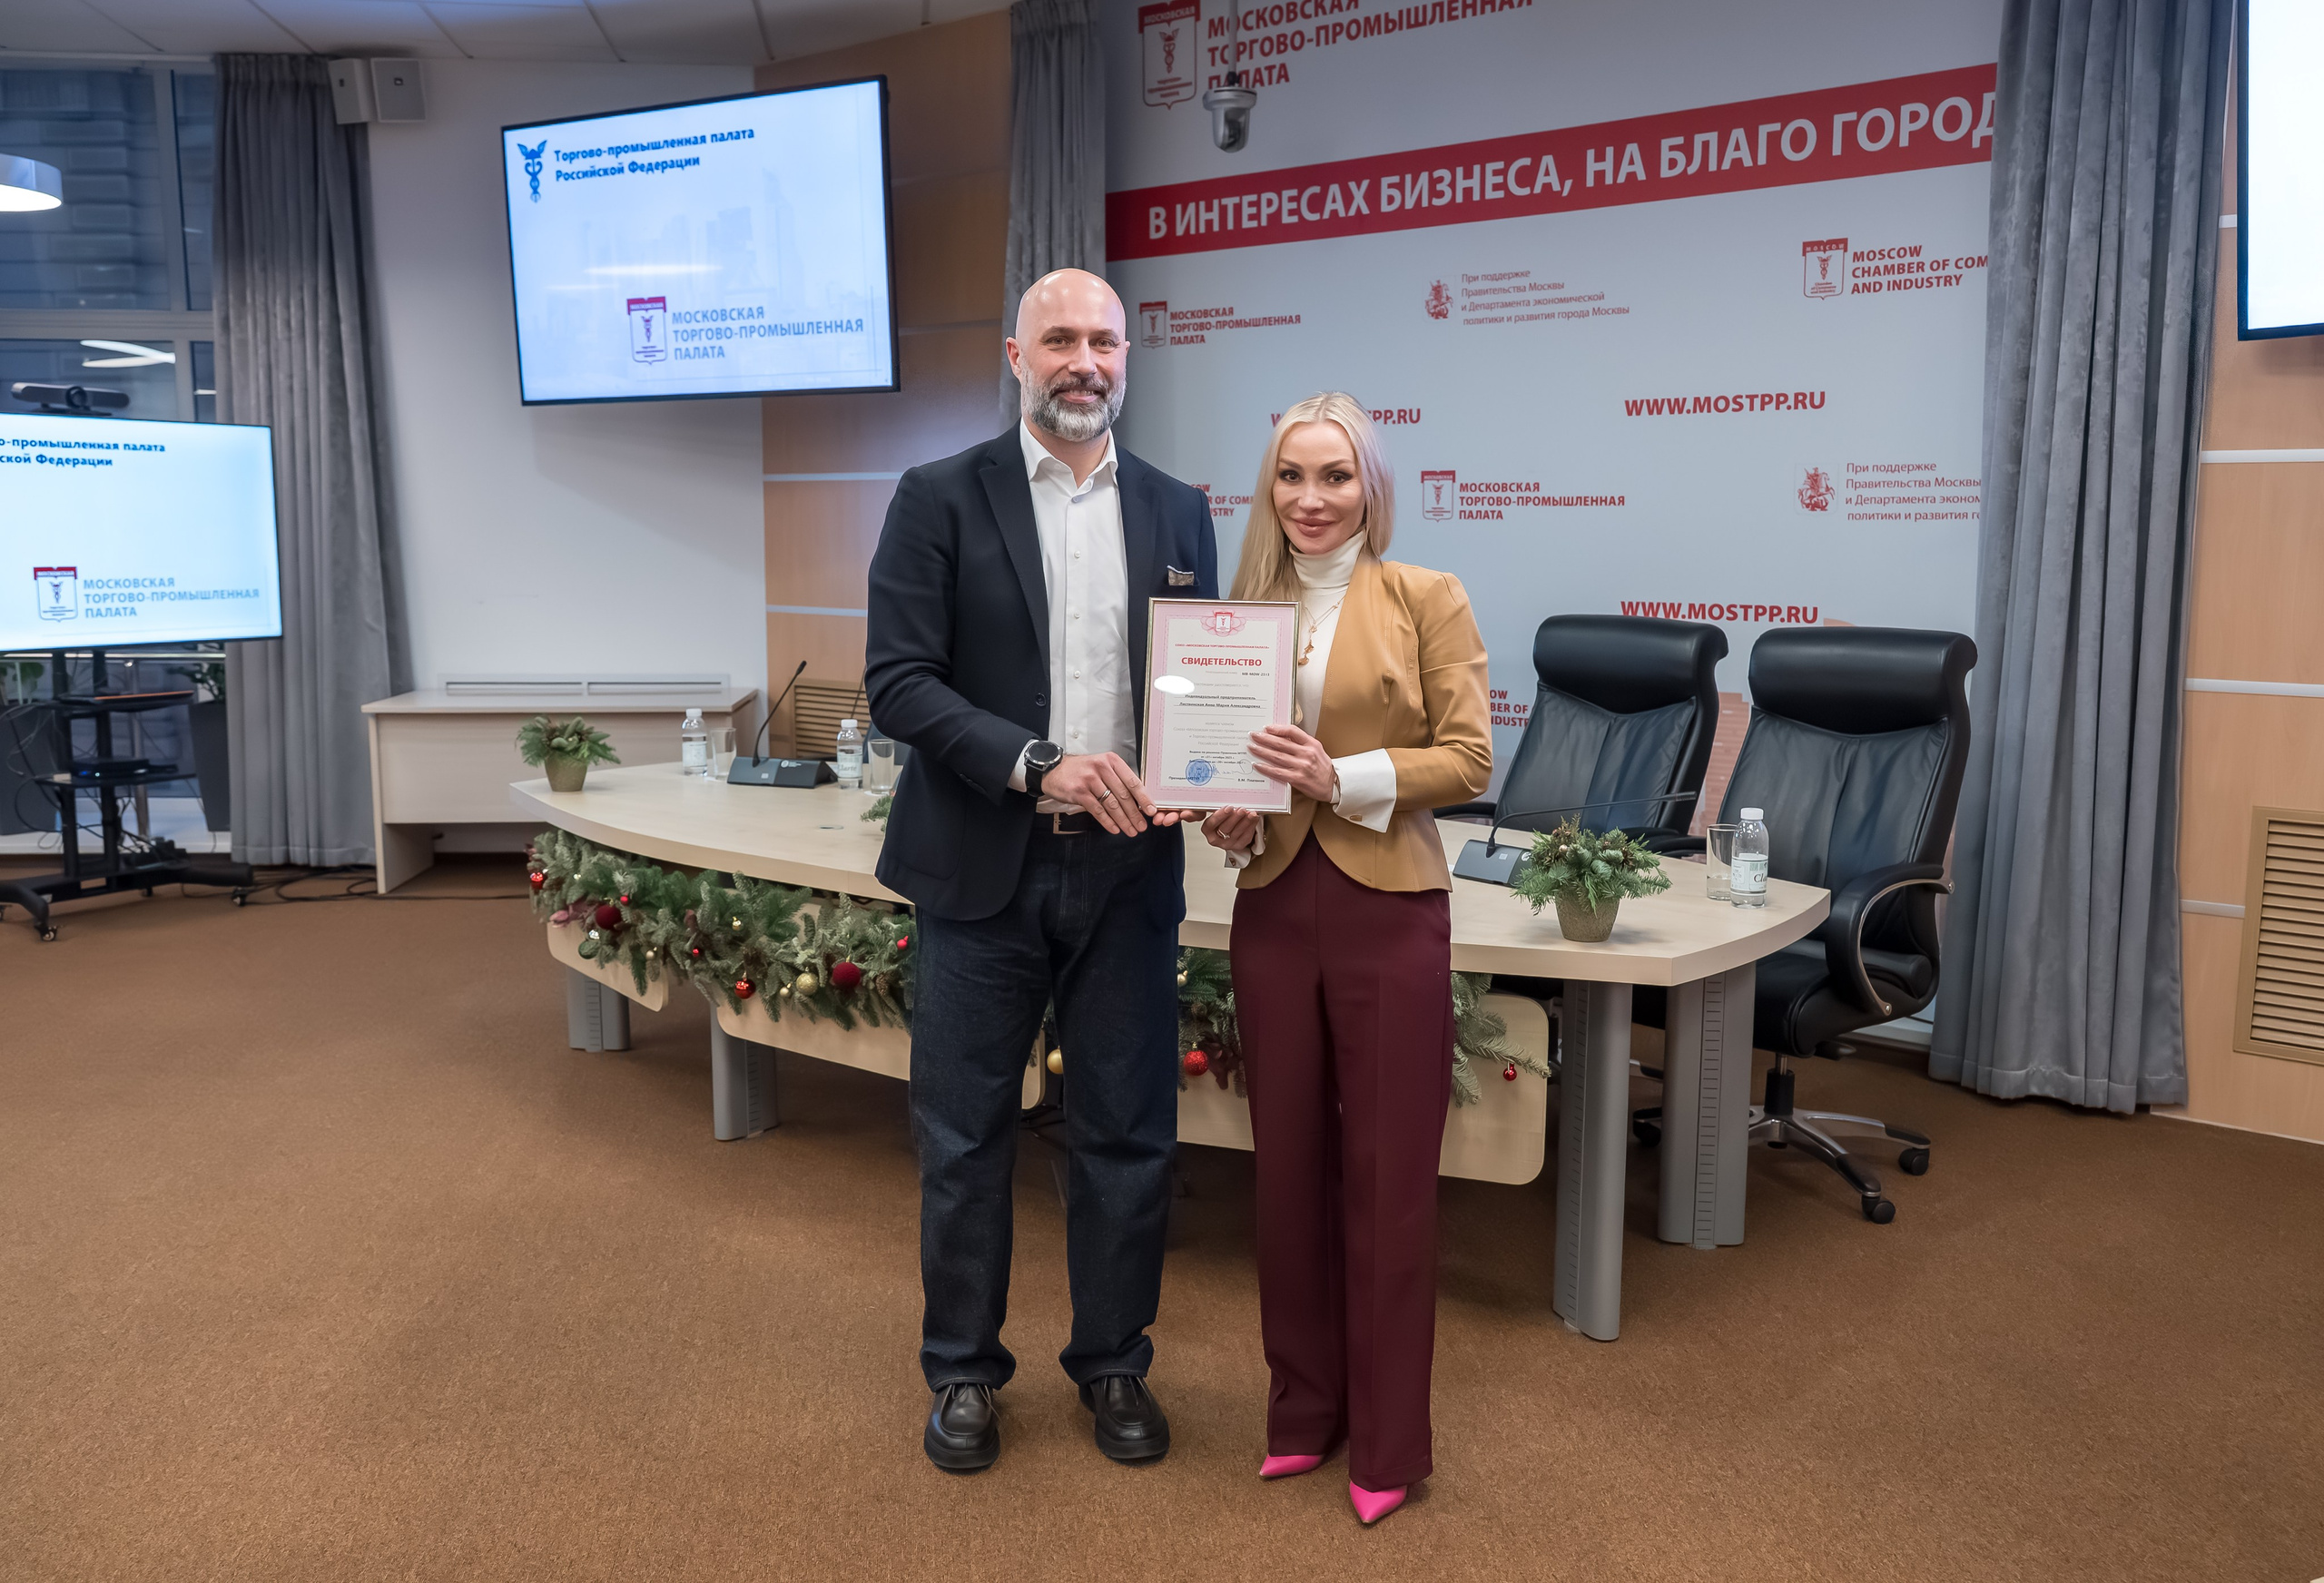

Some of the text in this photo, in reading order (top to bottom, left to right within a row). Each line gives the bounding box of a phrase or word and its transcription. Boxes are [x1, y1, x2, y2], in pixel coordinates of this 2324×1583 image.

[1207, 62, 1291, 90] ПЛАТА
[554, 127, 755, 163] Торгово-промышленная палата
[554, 154, 701, 182] Российской Федерации
[1148, 206, 1167, 240] В
[1175, 179, 1371, 236] ИНТЕРЕСАХ
[1379, 152, 1573, 213] БИЗНЕСА,
[1585, 143, 1647, 187] НА
[1659, 118, 1817, 178] БЛАГО
[1852, 245, 1923, 263] MOSCOW
[1851, 261, 1926, 279] CHAMBER
[1929, 258, 1951, 272] OF
[1461, 270, 1531, 284] При поддержке
[1850, 280, 1884, 295] AND
[1886, 272, 1964, 293] INDUSTRY
[1461, 280, 1565, 298] Правительства Москвы
[1461, 290, 1606, 312] и Департамента экономической
[672, 305, 765, 325] МОСКОВСКАЯ
[1169, 306, 1235, 321] МОСКОВСКАЯ
[1462, 315, 1504, 326] политики
[1513, 311, 1556, 324] развития
[1557, 310, 1590, 320] города
[1591, 305, 1630, 318] Москвы
[672, 318, 864, 343] ТОРГОВО-ПРОМЫШЛЕННАЯ
[1169, 314, 1302, 334] ТОРГОВО-ПРОМЫШЛЕННАЯ
[1169, 334, 1206, 346] ПАЛАТА
[674, 345, 725, 361] ПАЛАТА
[1624, 390, 1827, 417] WWW.MOSTPP.RU
[123, 441, 166, 453] палата
[34, 453, 113, 468] Федерации
[1846, 461, 1937, 475] При поддержке
[1458, 481, 1541, 493] МОСКОВСКАЯ
[1846, 476, 1982, 491] Правительства Москвы
[1215, 496, 1226, 505] OF
[1458, 495, 1626, 507] ТОРГОВО-ПРОМЫШЛЕННАЯ
[1845, 497, 1852, 505] и
[1854, 494, 1936, 506] Департамента
[1458, 509, 1504, 520] ПАЛАТА
[1846, 512, 1903, 522] политики
[1904, 512, 1912, 520] и
[1914, 511, 1969, 523] развития
[83, 576, 176, 590] МОСКОВСКАЯ
[83, 588, 261, 605] ТОРГОВО-ПРОМЫШЛЕННАЯ
[84, 606, 138, 619] ПАЛАТА
[1620, 600, 1819, 624] WWW.MOSTPP.RU
[1181, 656, 1263, 667] СВИДЕТЕЛЬСТВО
[1513, 703, 1529, 714] OF
